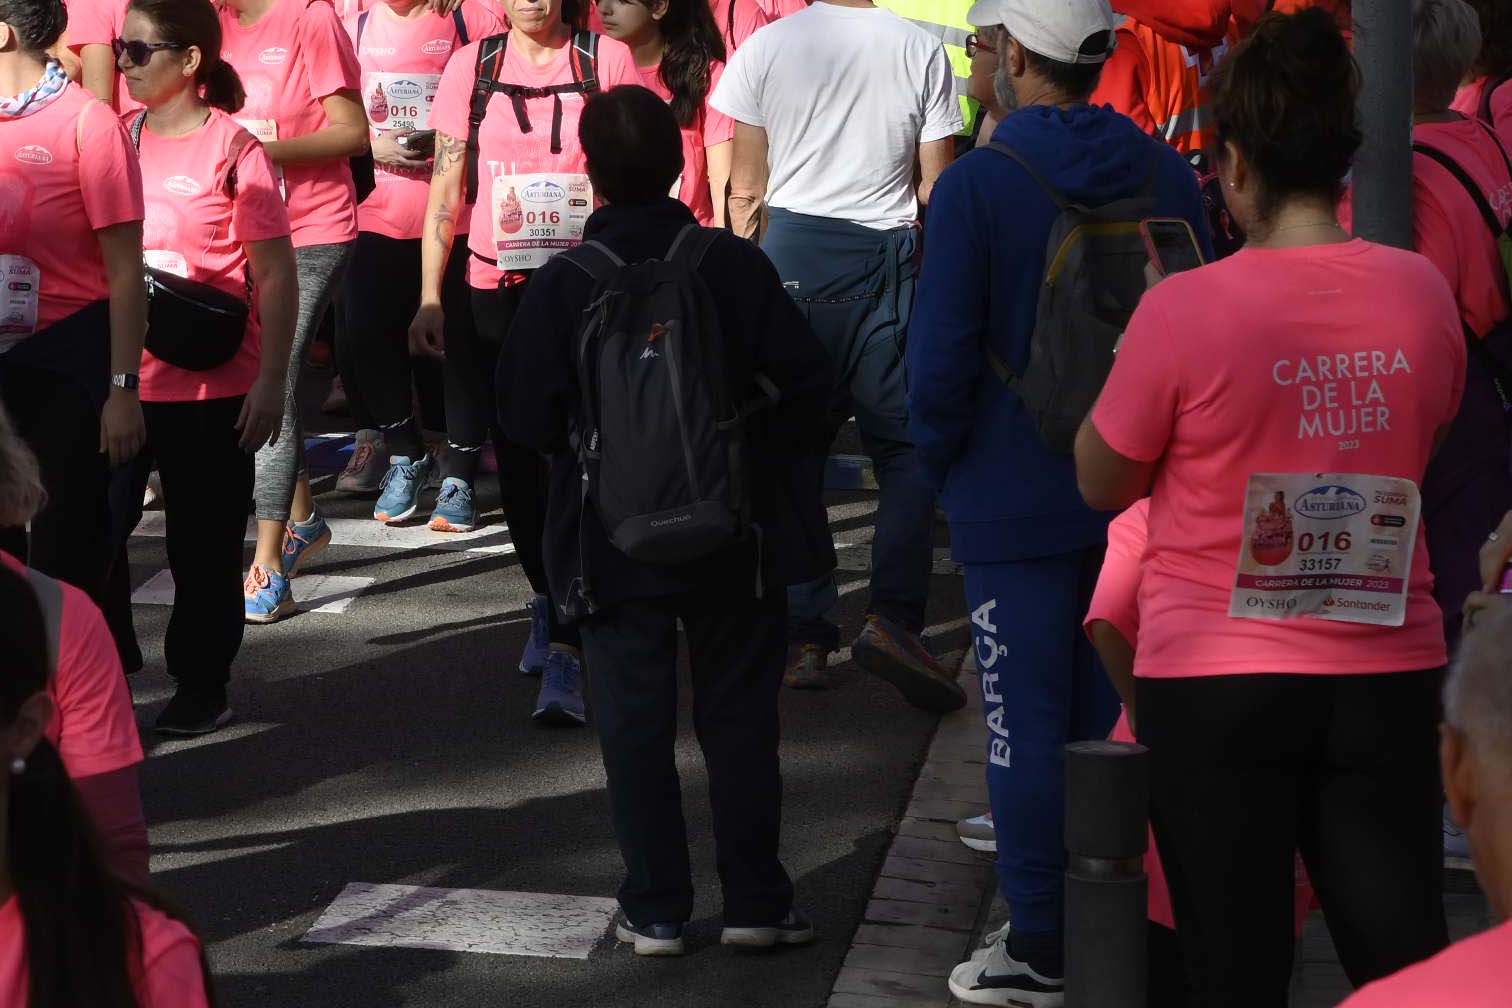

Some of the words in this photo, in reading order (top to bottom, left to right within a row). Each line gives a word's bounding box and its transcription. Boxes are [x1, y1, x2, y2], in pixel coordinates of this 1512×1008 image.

[391, 105, 418, 117] 016
[527, 211, 560, 224] 016
[1272, 349, 1414, 386] CARRERA
[1302, 382, 1339, 411] DE
[1351, 379, 1386, 406] LA
[1297, 407, 1392, 440] MUJER
[1301, 498, 1361, 512] ASTURIANA
[1373, 495, 1408, 507] SUMA
[650, 514, 692, 528] Quechua
[1297, 531, 1352, 552] 016
[1299, 558, 1342, 572] 33157
[1255, 579, 1299, 588] CARRERA
[1301, 578, 1313, 586] DE
[1315, 578, 1328, 586] LA
[1329, 578, 1363, 587] MUJER
[1366, 580, 1390, 589] 2023
[1246, 596, 1297, 609] OYSHO
[1336, 597, 1392, 611] Santander
[971, 598, 1011, 768] BARÇA
